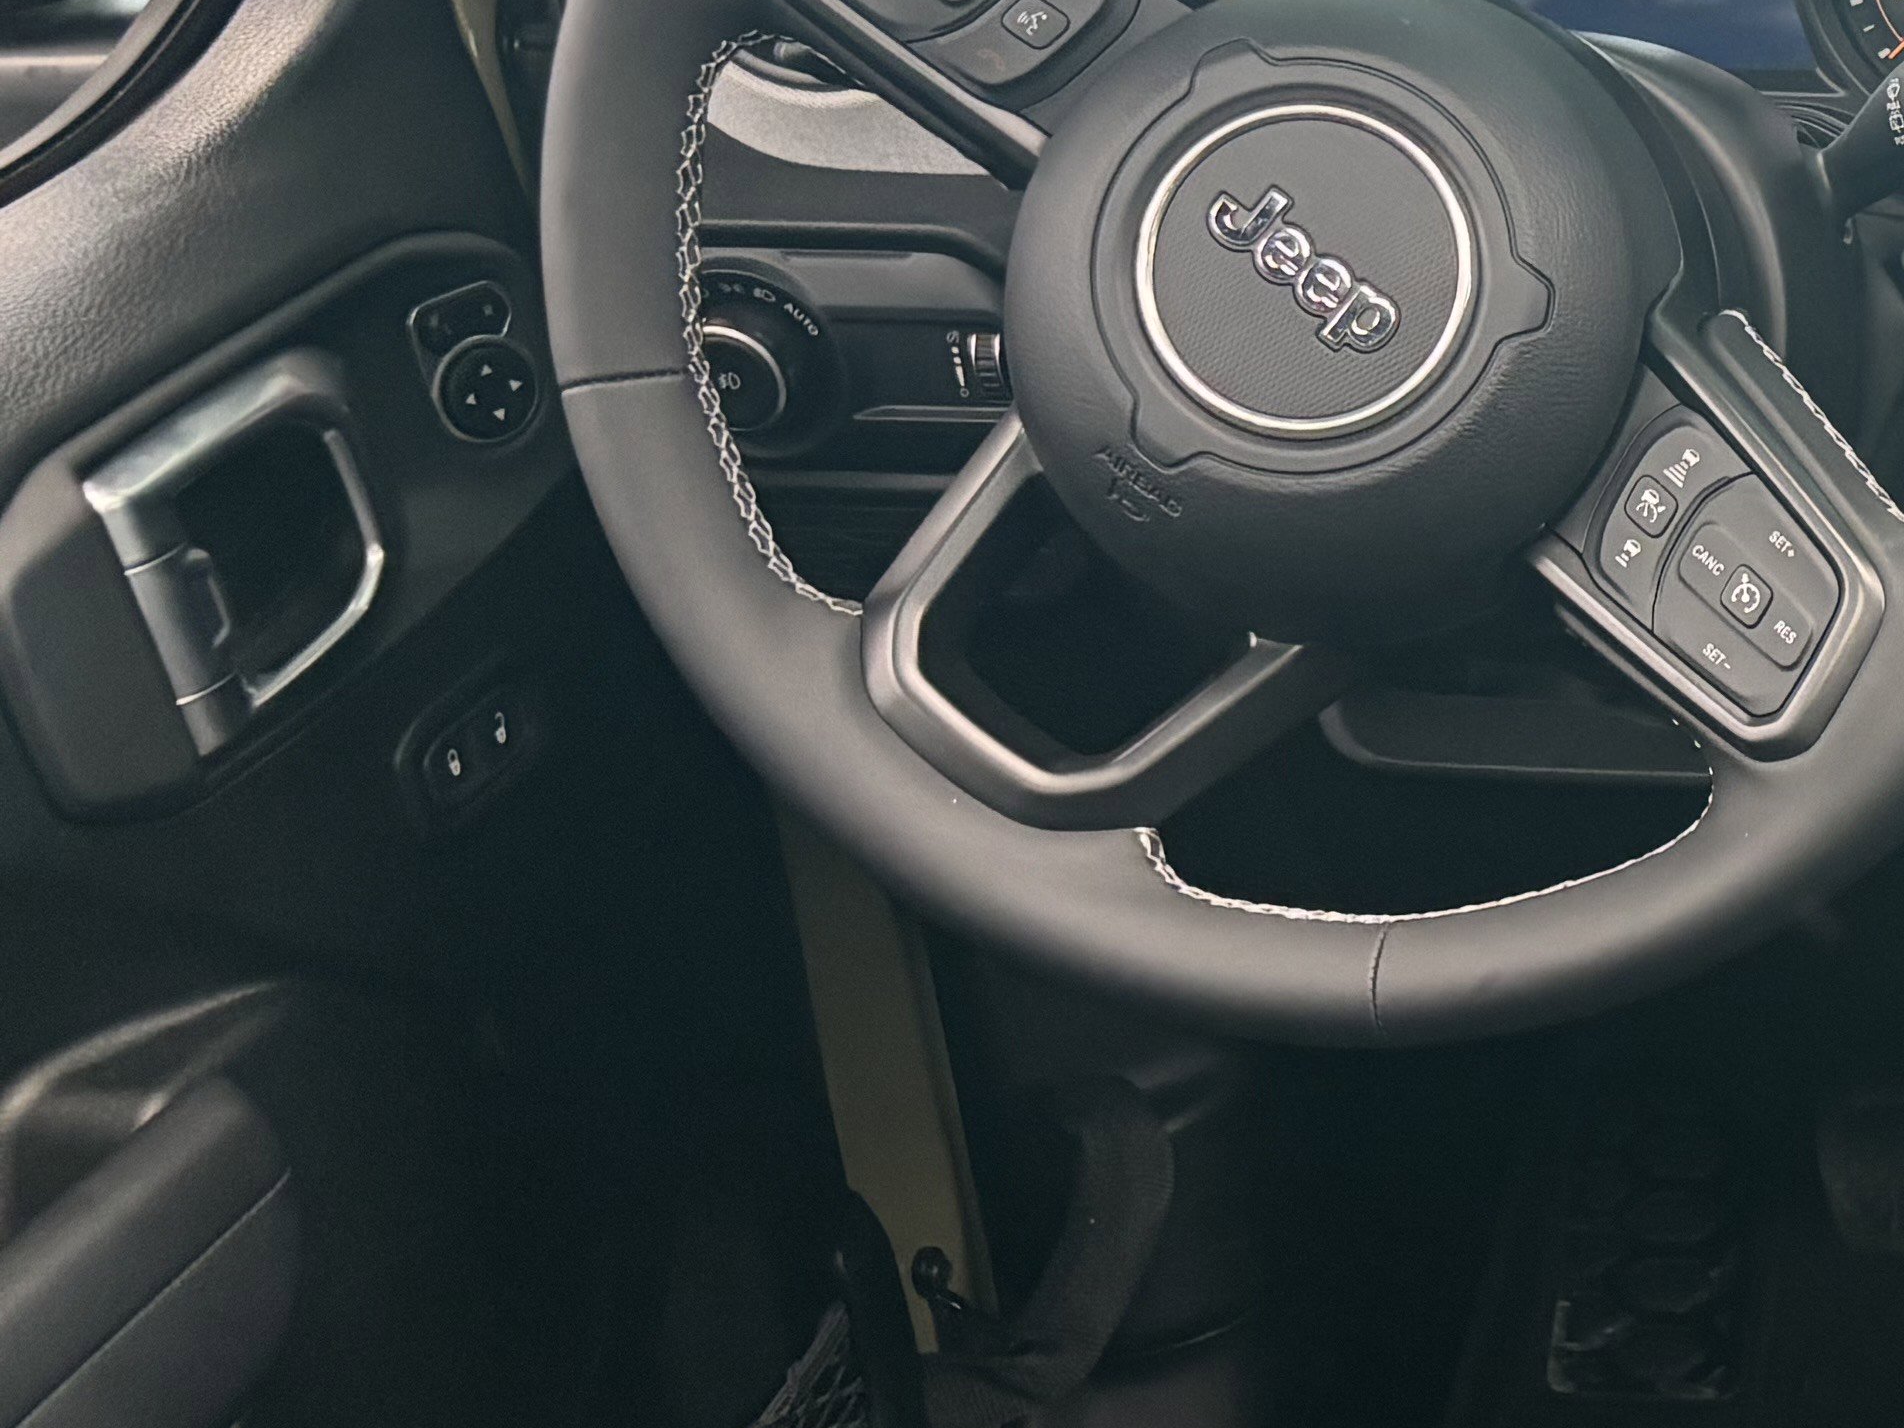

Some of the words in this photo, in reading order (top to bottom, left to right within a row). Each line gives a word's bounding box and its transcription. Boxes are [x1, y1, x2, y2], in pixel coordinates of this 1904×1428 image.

[1206, 184, 1402, 354] Jeep
[783, 302, 820, 337] AUTO
[1692, 545, 1724, 576] CANC
[1774, 621, 1797, 644] RES
